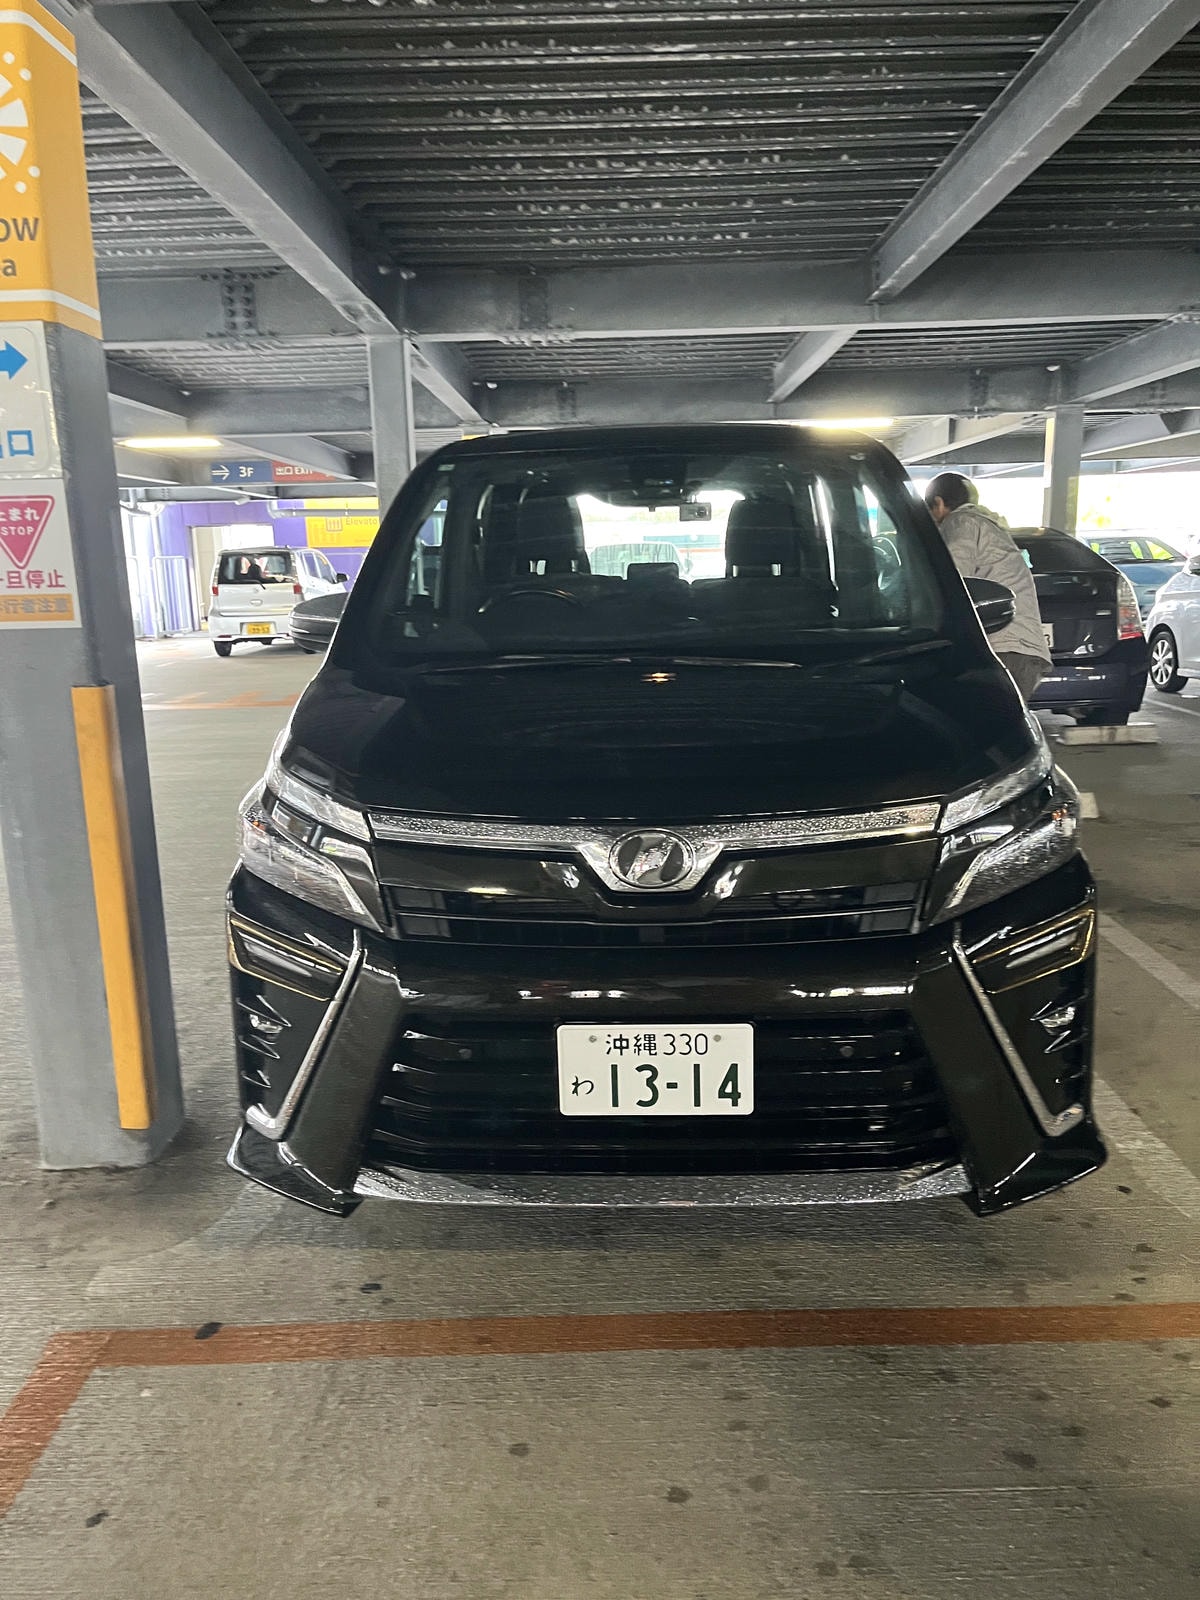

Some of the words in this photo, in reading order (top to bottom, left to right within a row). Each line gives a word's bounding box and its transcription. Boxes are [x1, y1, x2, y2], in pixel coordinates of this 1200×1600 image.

[0, 430, 35, 459] 口
[239, 466, 254, 478] 3F
[0, 526, 35, 536] STOP
[0, 569, 66, 589] 旦停止
[571, 1075, 595, 1097] わ
[610, 1063, 742, 1108] 13-14
